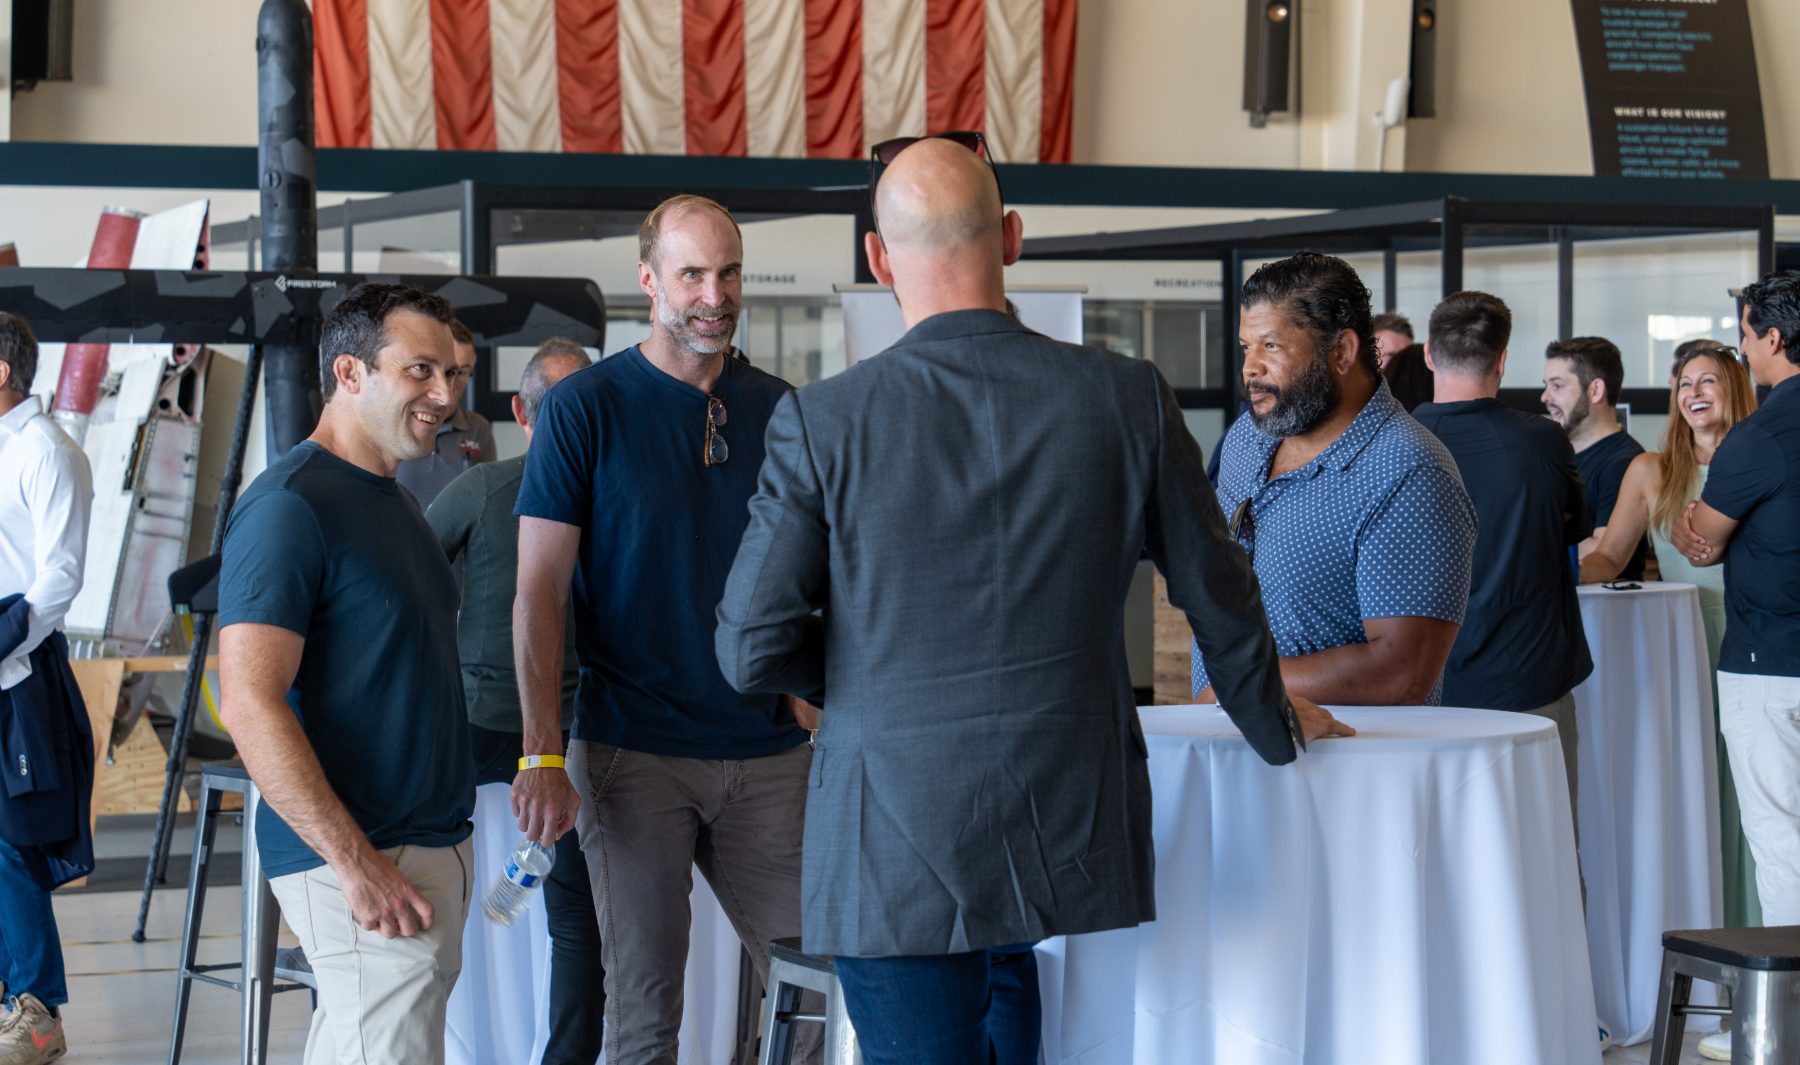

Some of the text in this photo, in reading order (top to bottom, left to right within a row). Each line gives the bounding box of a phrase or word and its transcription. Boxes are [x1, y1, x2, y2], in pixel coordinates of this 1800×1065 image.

[1614, 107, 1727, 119] WHAT IS OUR VISION?
[287, 280, 336, 288] FIRESTORM
